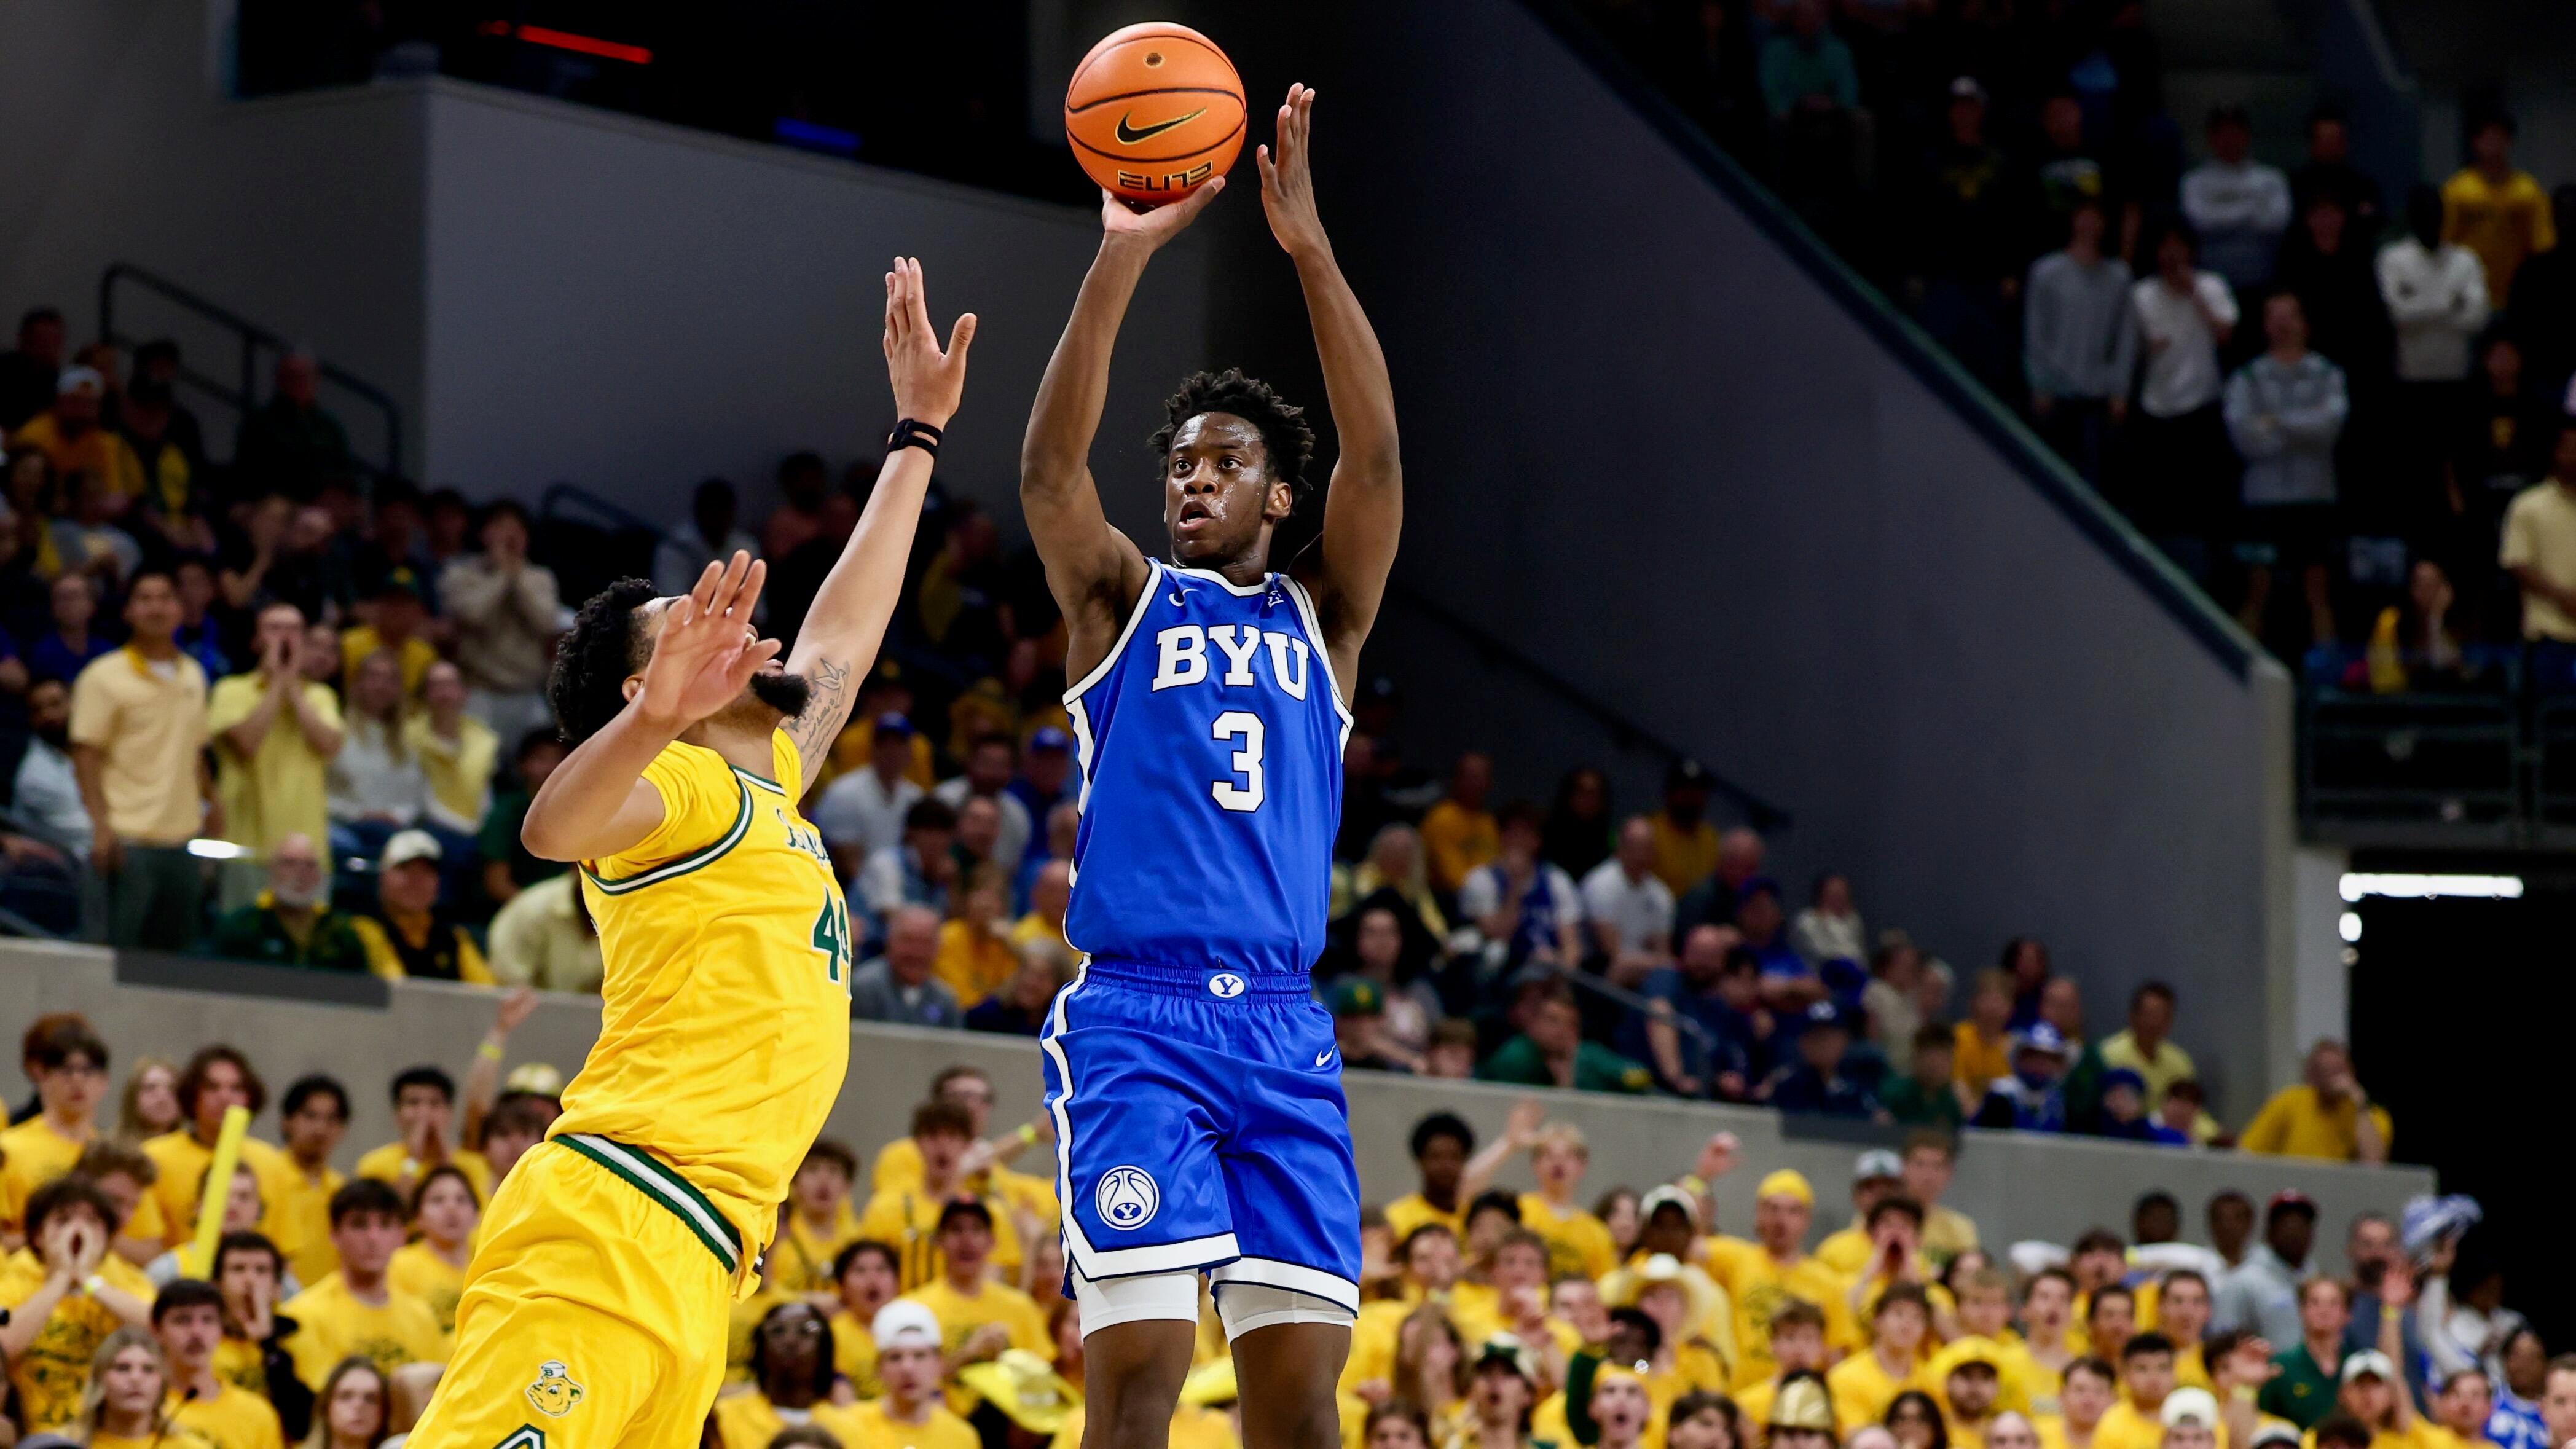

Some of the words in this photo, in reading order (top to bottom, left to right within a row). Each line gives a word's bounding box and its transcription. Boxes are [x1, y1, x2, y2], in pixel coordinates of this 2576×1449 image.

[1118, 160, 1212, 192] ELITE
[1151, 624, 1309, 702] BYU
[1211, 710, 1266, 814] 3
[1216, 976, 1238, 995] Y
[1117, 1204, 1137, 1219] Y
